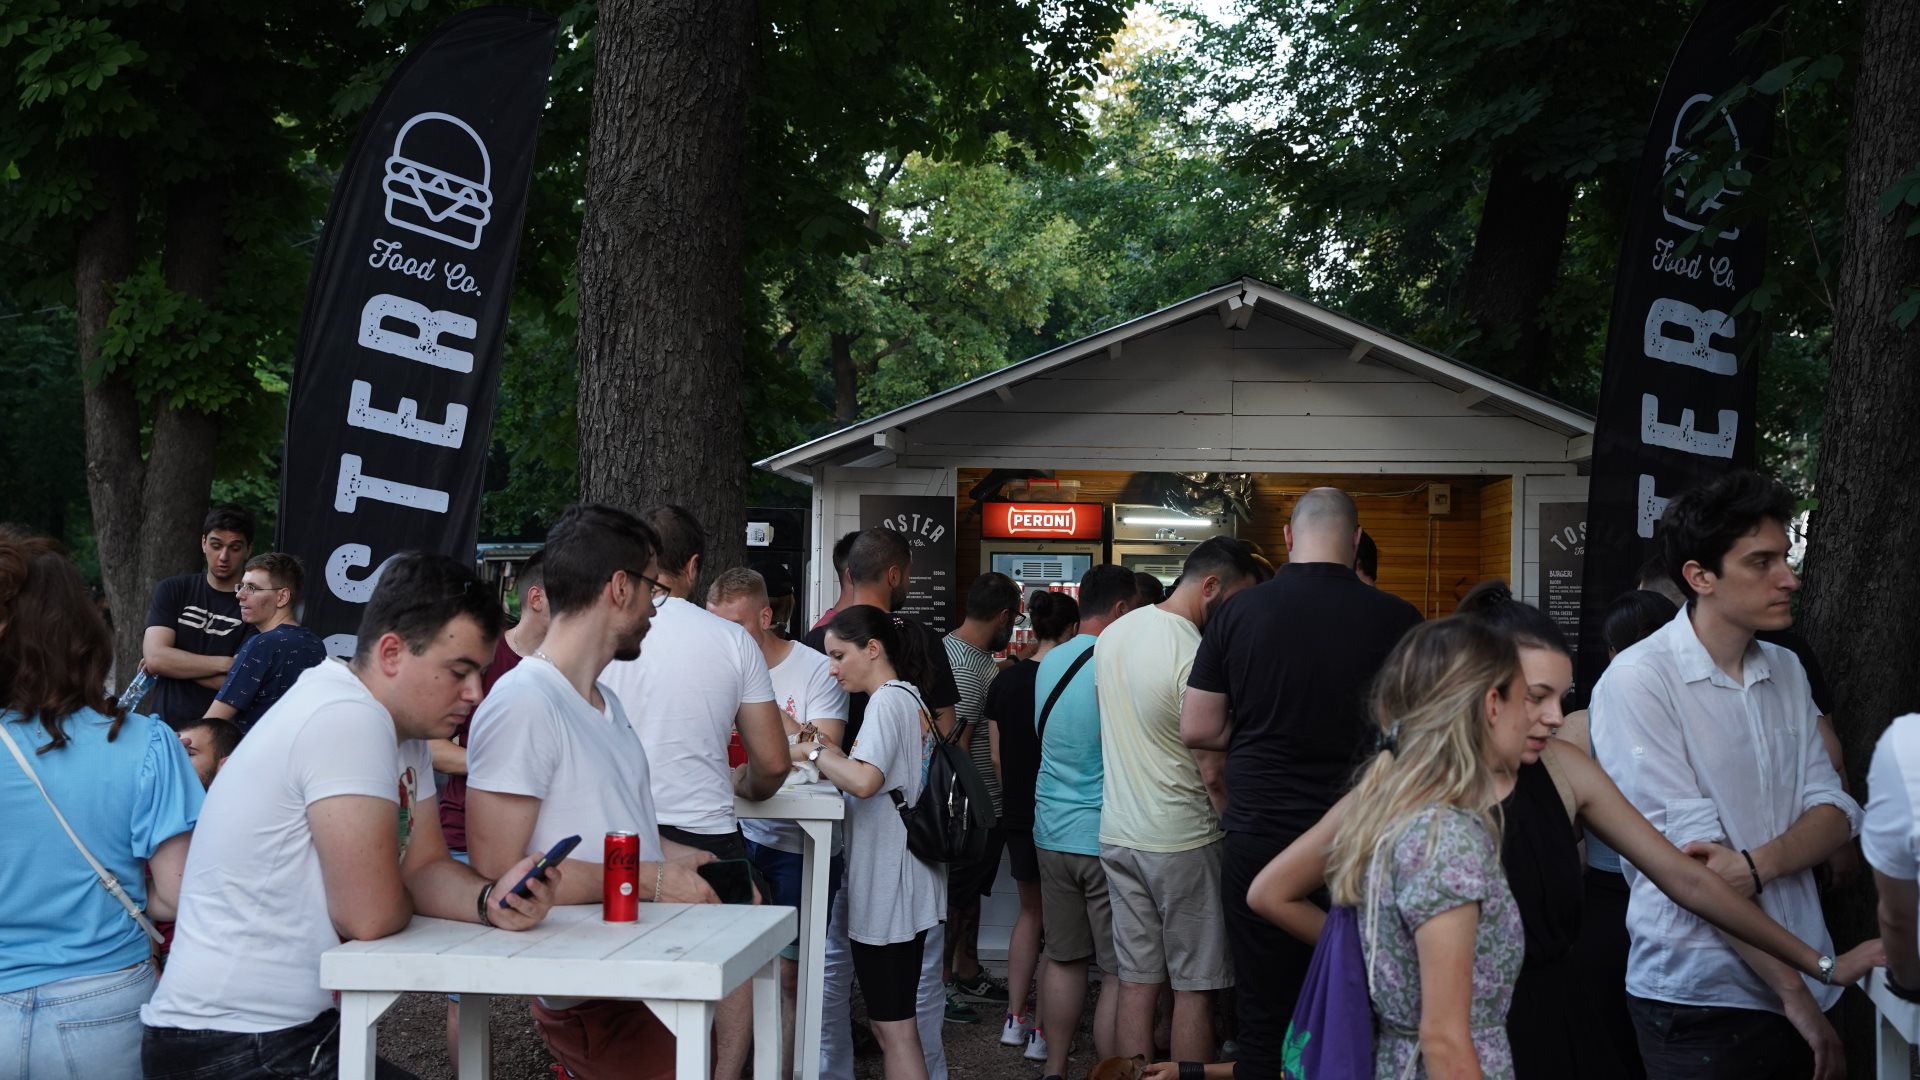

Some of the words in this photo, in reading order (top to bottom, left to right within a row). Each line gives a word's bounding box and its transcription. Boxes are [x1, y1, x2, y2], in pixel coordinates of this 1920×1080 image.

[368, 238, 436, 283] Food
[443, 261, 483, 298] Co.
[1652, 237, 1703, 279] Food
[882, 513, 946, 543] OSTER
[1012, 513, 1071, 528] PERONI
